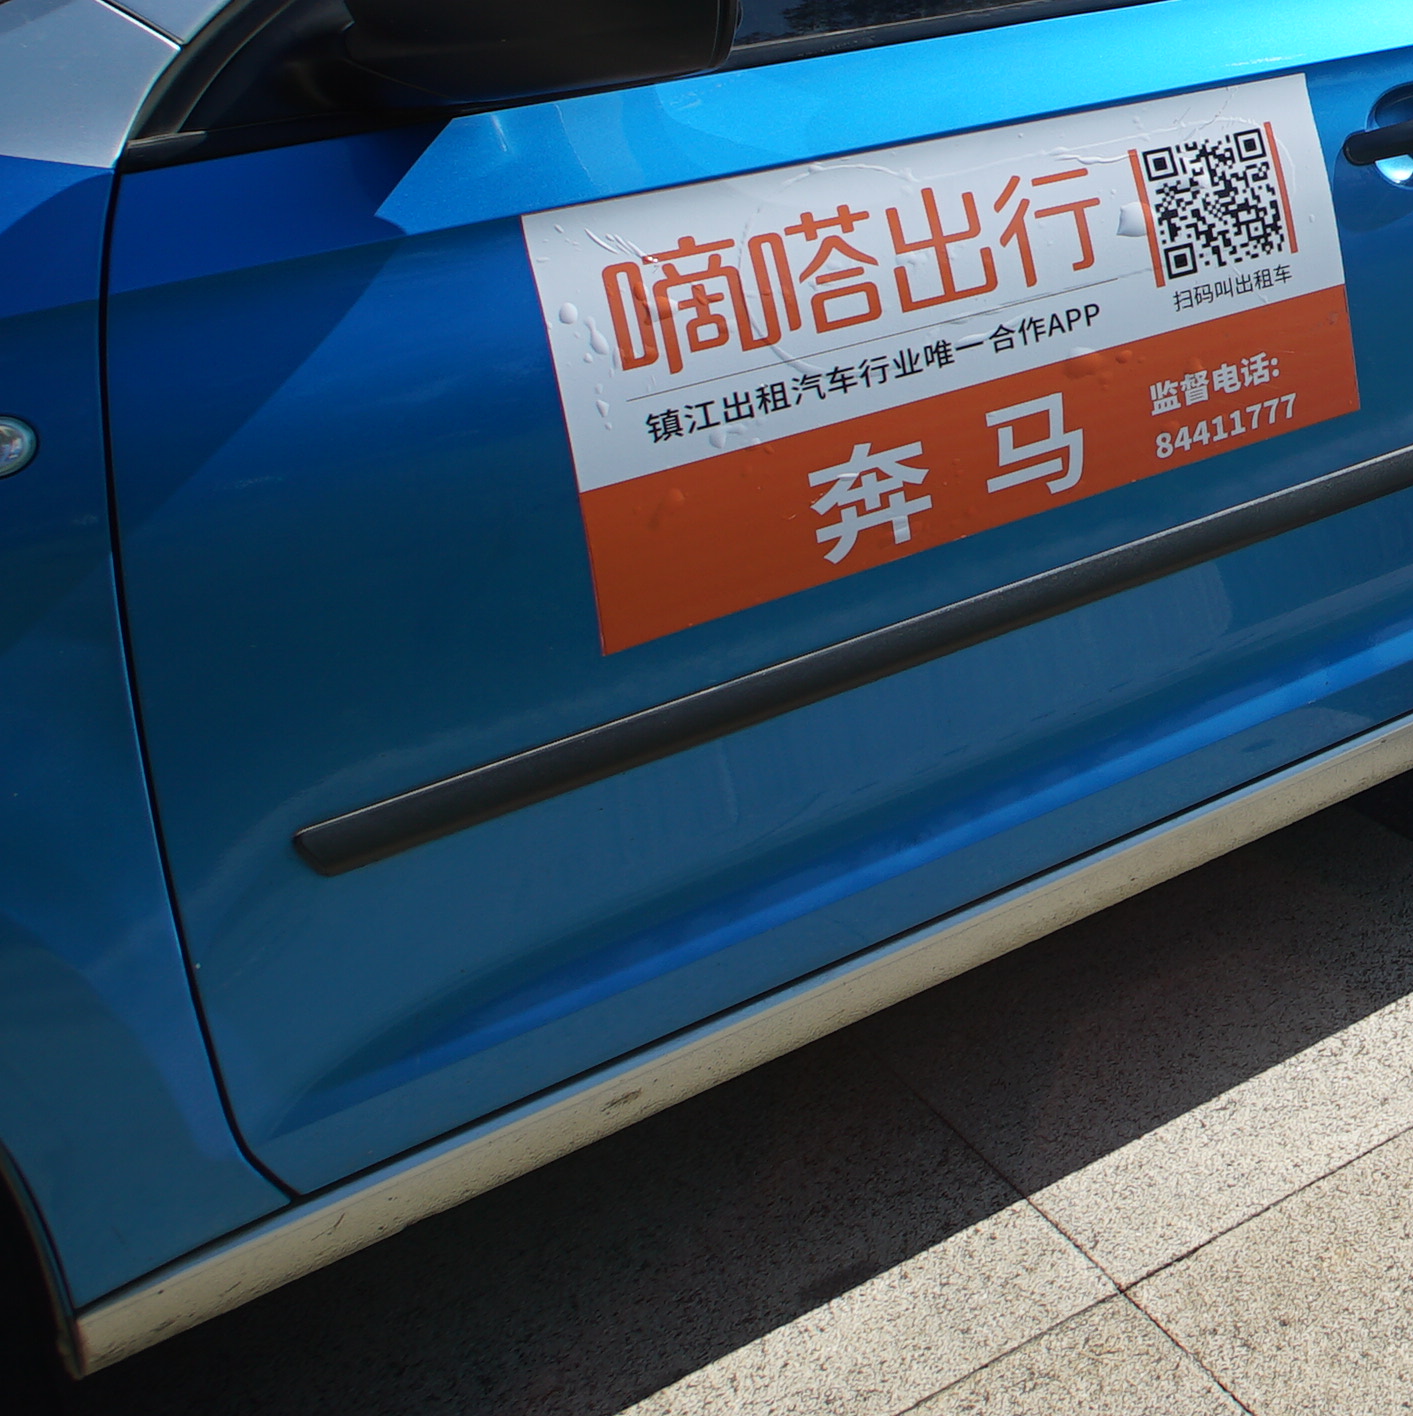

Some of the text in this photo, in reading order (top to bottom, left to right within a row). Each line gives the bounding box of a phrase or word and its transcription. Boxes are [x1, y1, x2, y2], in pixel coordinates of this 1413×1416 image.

[601, 167, 1102, 375] 嘀嗒出行
[1173, 262, 1294, 313] 扫码叫出租车
[644, 301, 1102, 445] 镇江出租汽车行业唯一合作APP
[1154, 392, 1298, 460] 84411777
[808, 390, 1086, 566] 奔马
